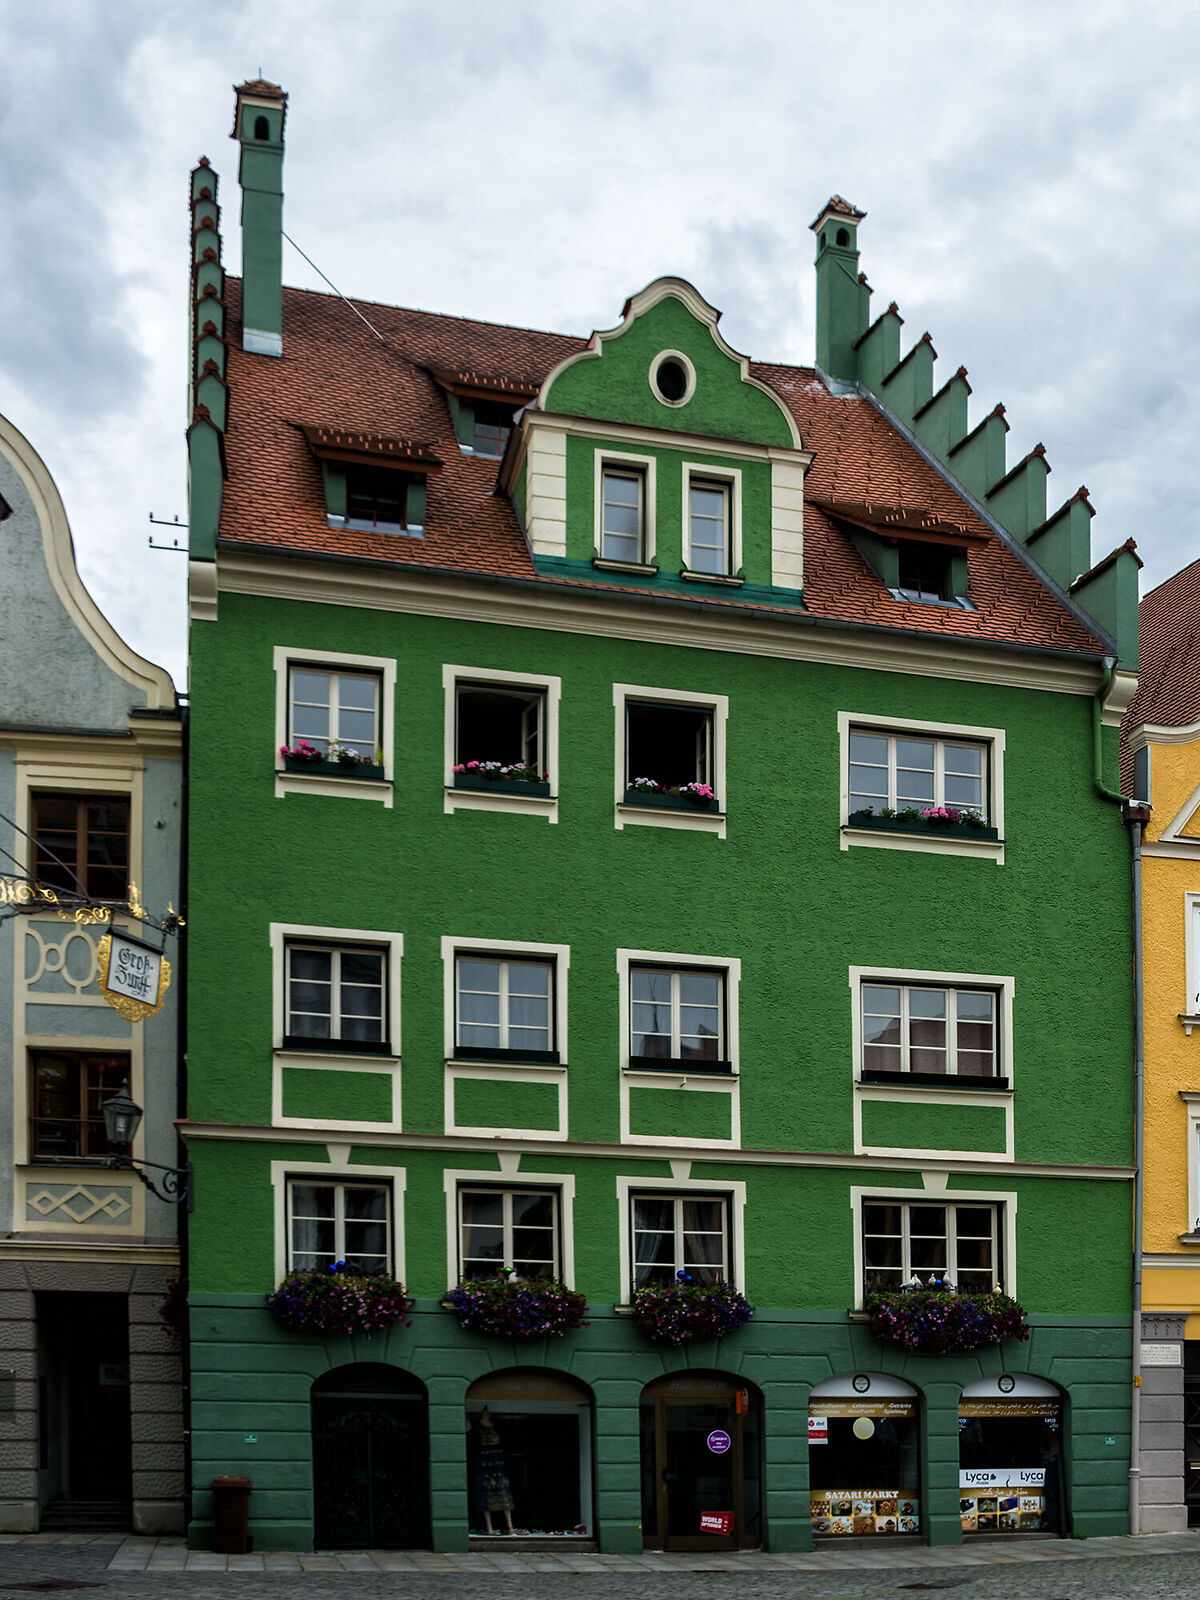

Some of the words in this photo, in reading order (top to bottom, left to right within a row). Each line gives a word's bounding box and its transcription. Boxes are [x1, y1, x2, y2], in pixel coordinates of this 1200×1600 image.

[965, 1471, 989, 1482] Lyca
[1020, 1471, 1044, 1482] Lyca
[825, 1491, 862, 1499] SATARI
[864, 1491, 899, 1499] MARKT
